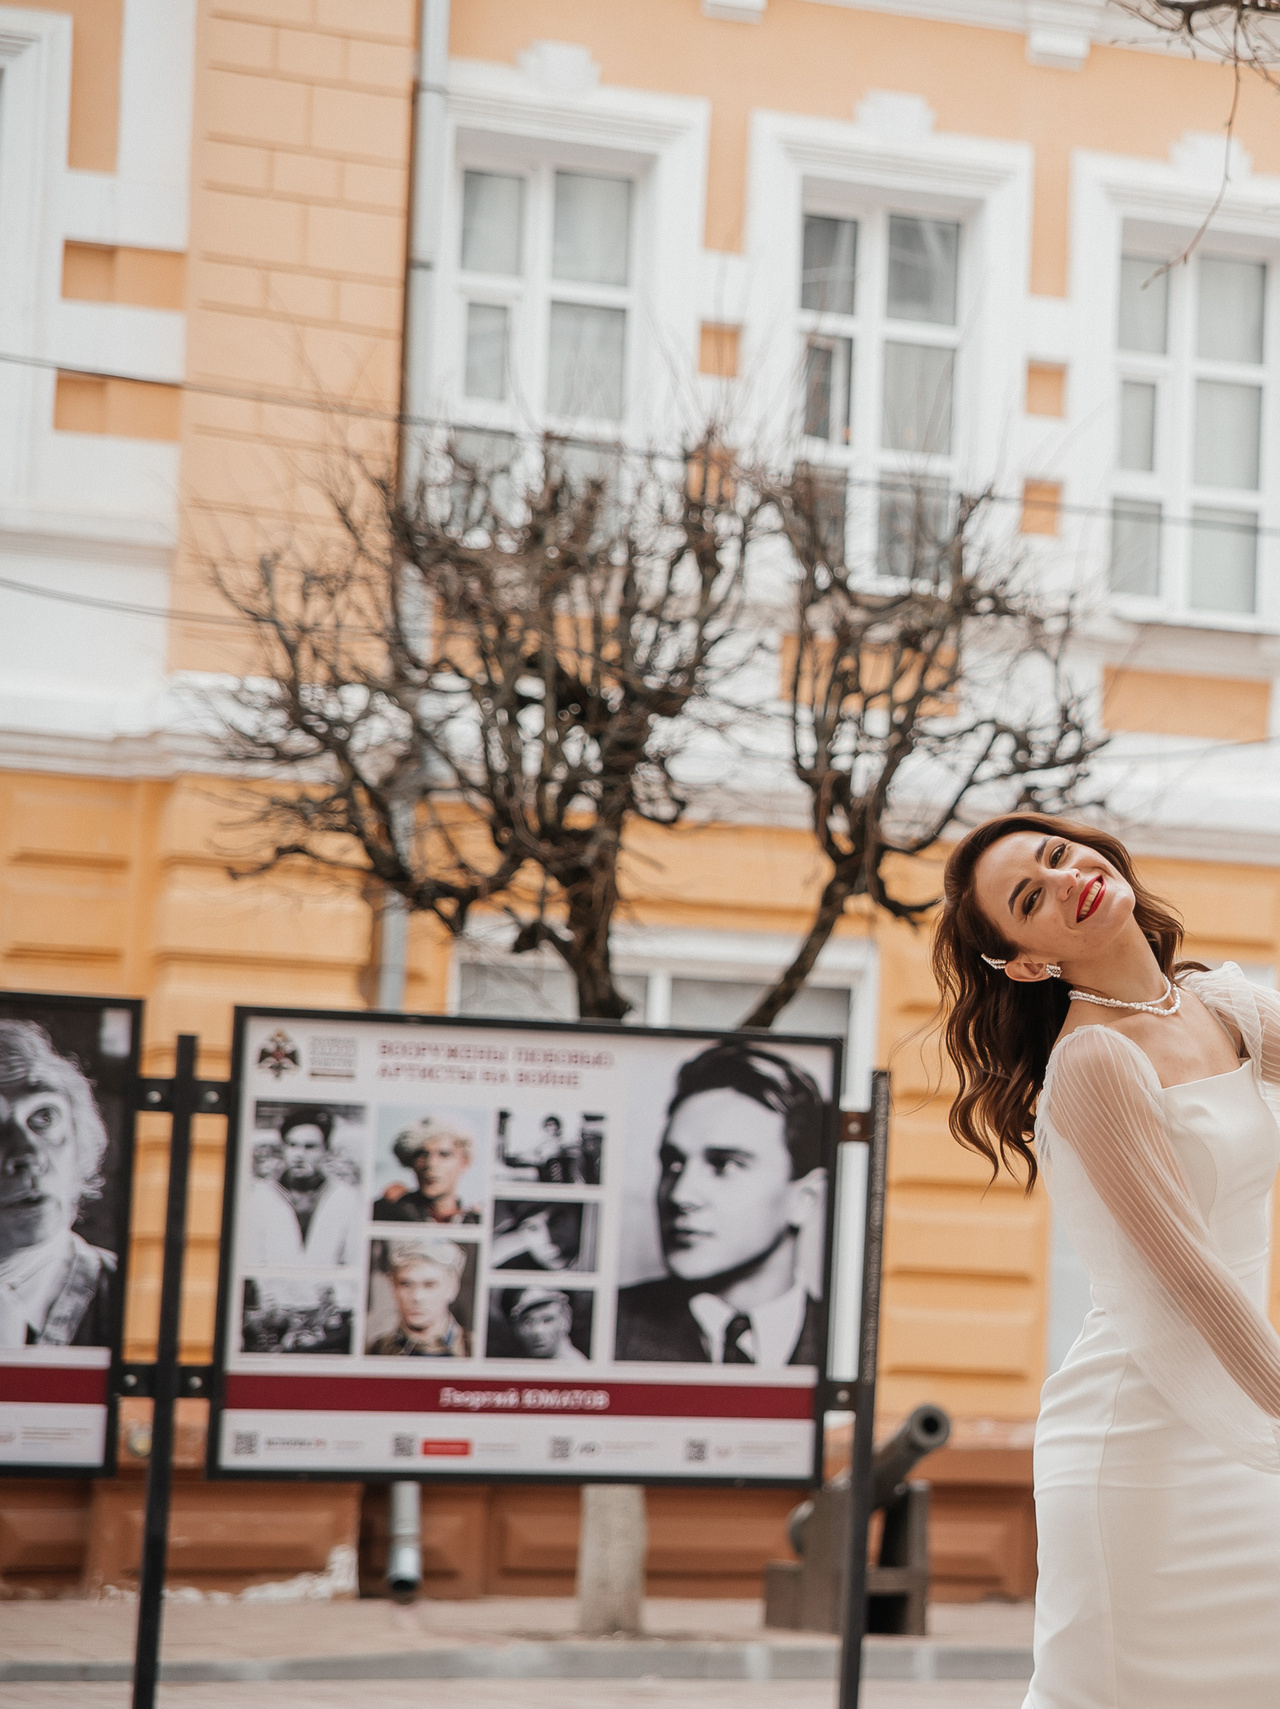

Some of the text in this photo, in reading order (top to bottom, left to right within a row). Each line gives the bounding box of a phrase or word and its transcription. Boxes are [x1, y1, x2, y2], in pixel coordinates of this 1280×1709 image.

[377, 1062, 582, 1090] АРТИСТЫ НА ВОЙНЕ
[439, 1387, 610, 1411] Георгий ЮМАТОВ
